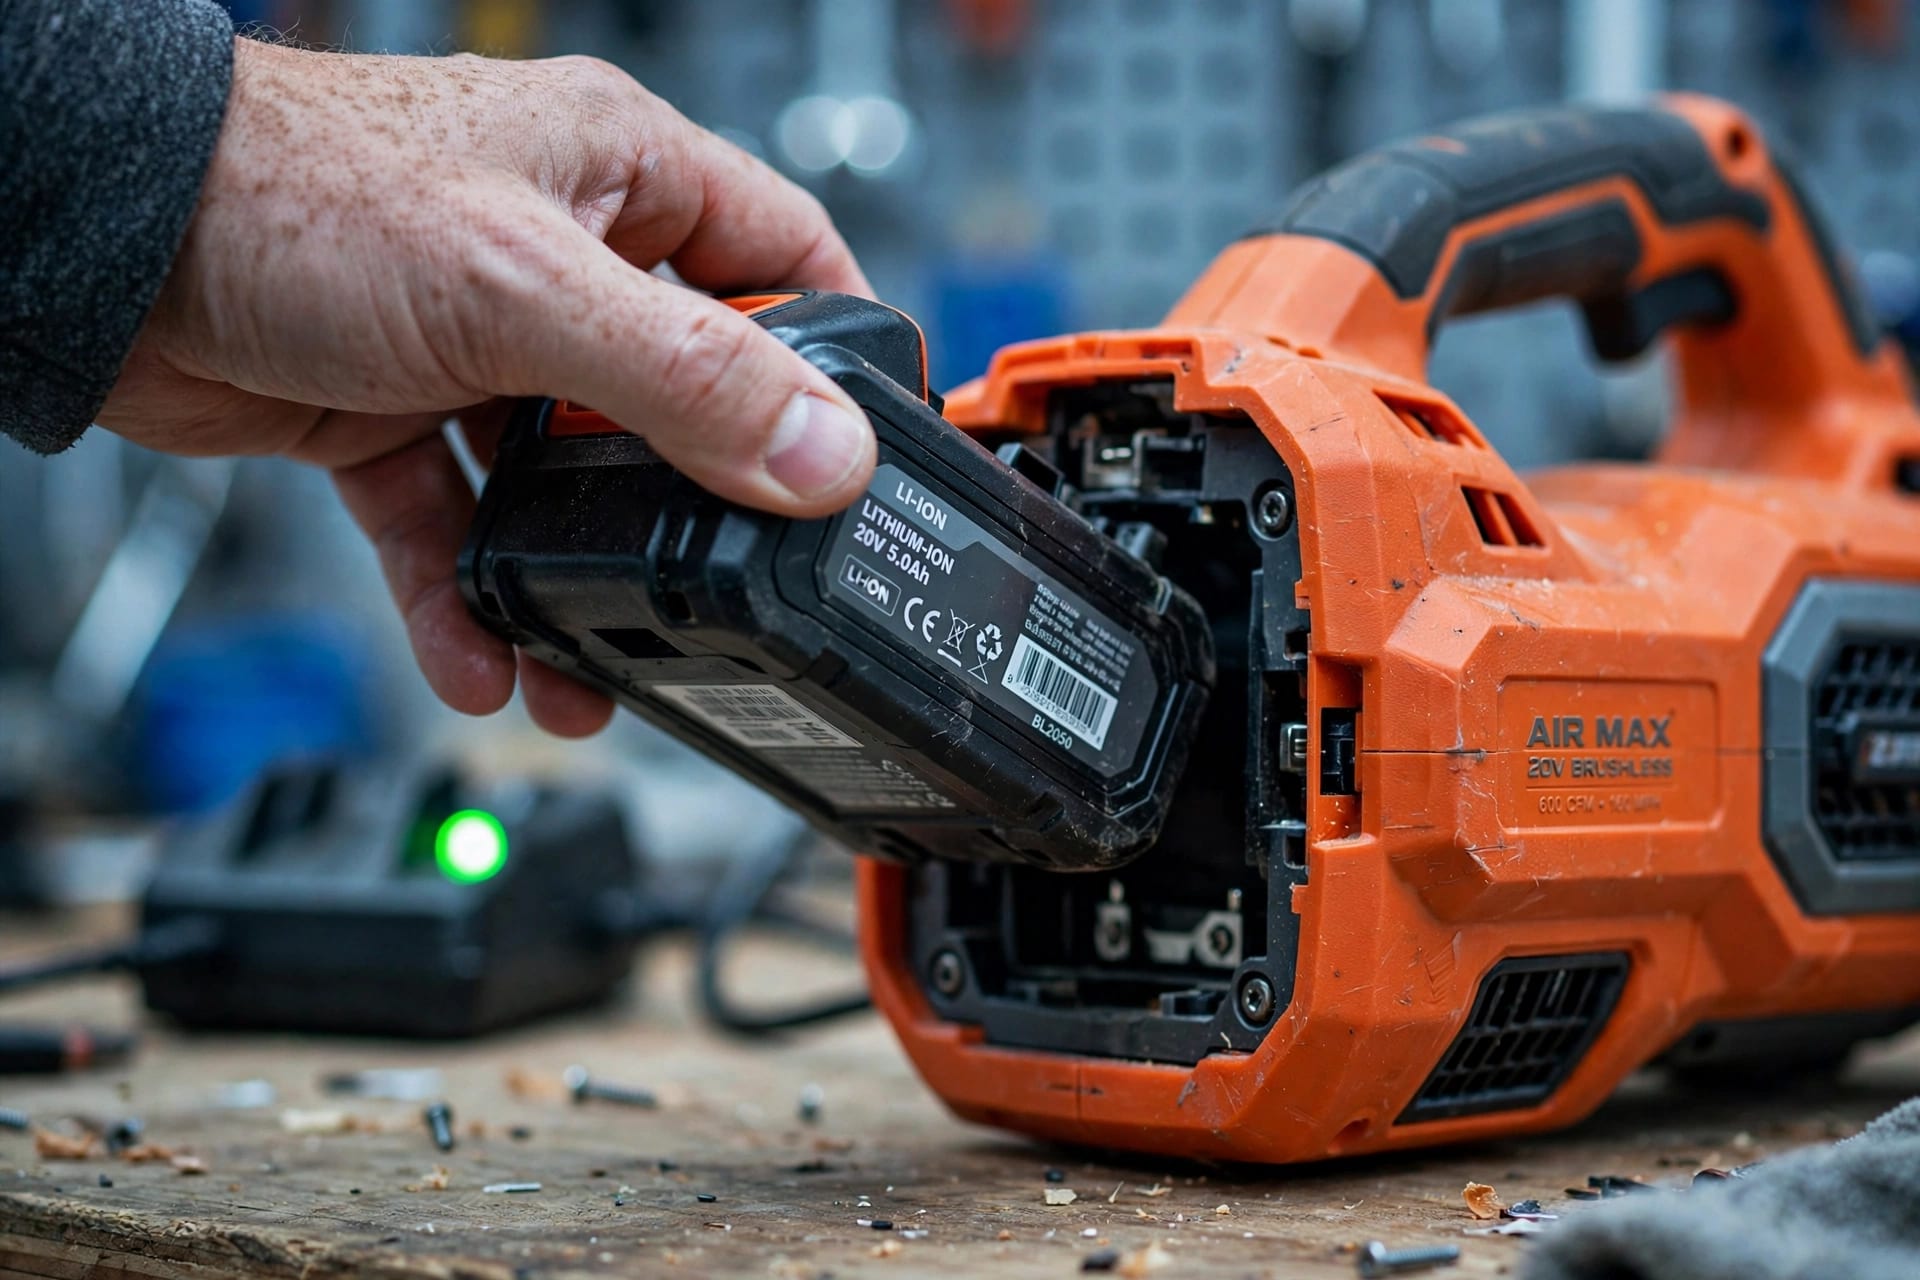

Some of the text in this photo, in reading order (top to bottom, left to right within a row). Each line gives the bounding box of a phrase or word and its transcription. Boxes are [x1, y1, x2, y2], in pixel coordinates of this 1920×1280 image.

[895, 481, 947, 530] LI-ION
[853, 522, 931, 586] 20V 5.0Ah
[861, 498, 954, 576] LITHIUM-ION
[1031, 714, 1073, 750] BL2050
[1527, 715, 1671, 748] AIR MAX
[1527, 756, 1673, 779] 20V BRUSHLESS
[1539, 795, 1562, 813] 600
